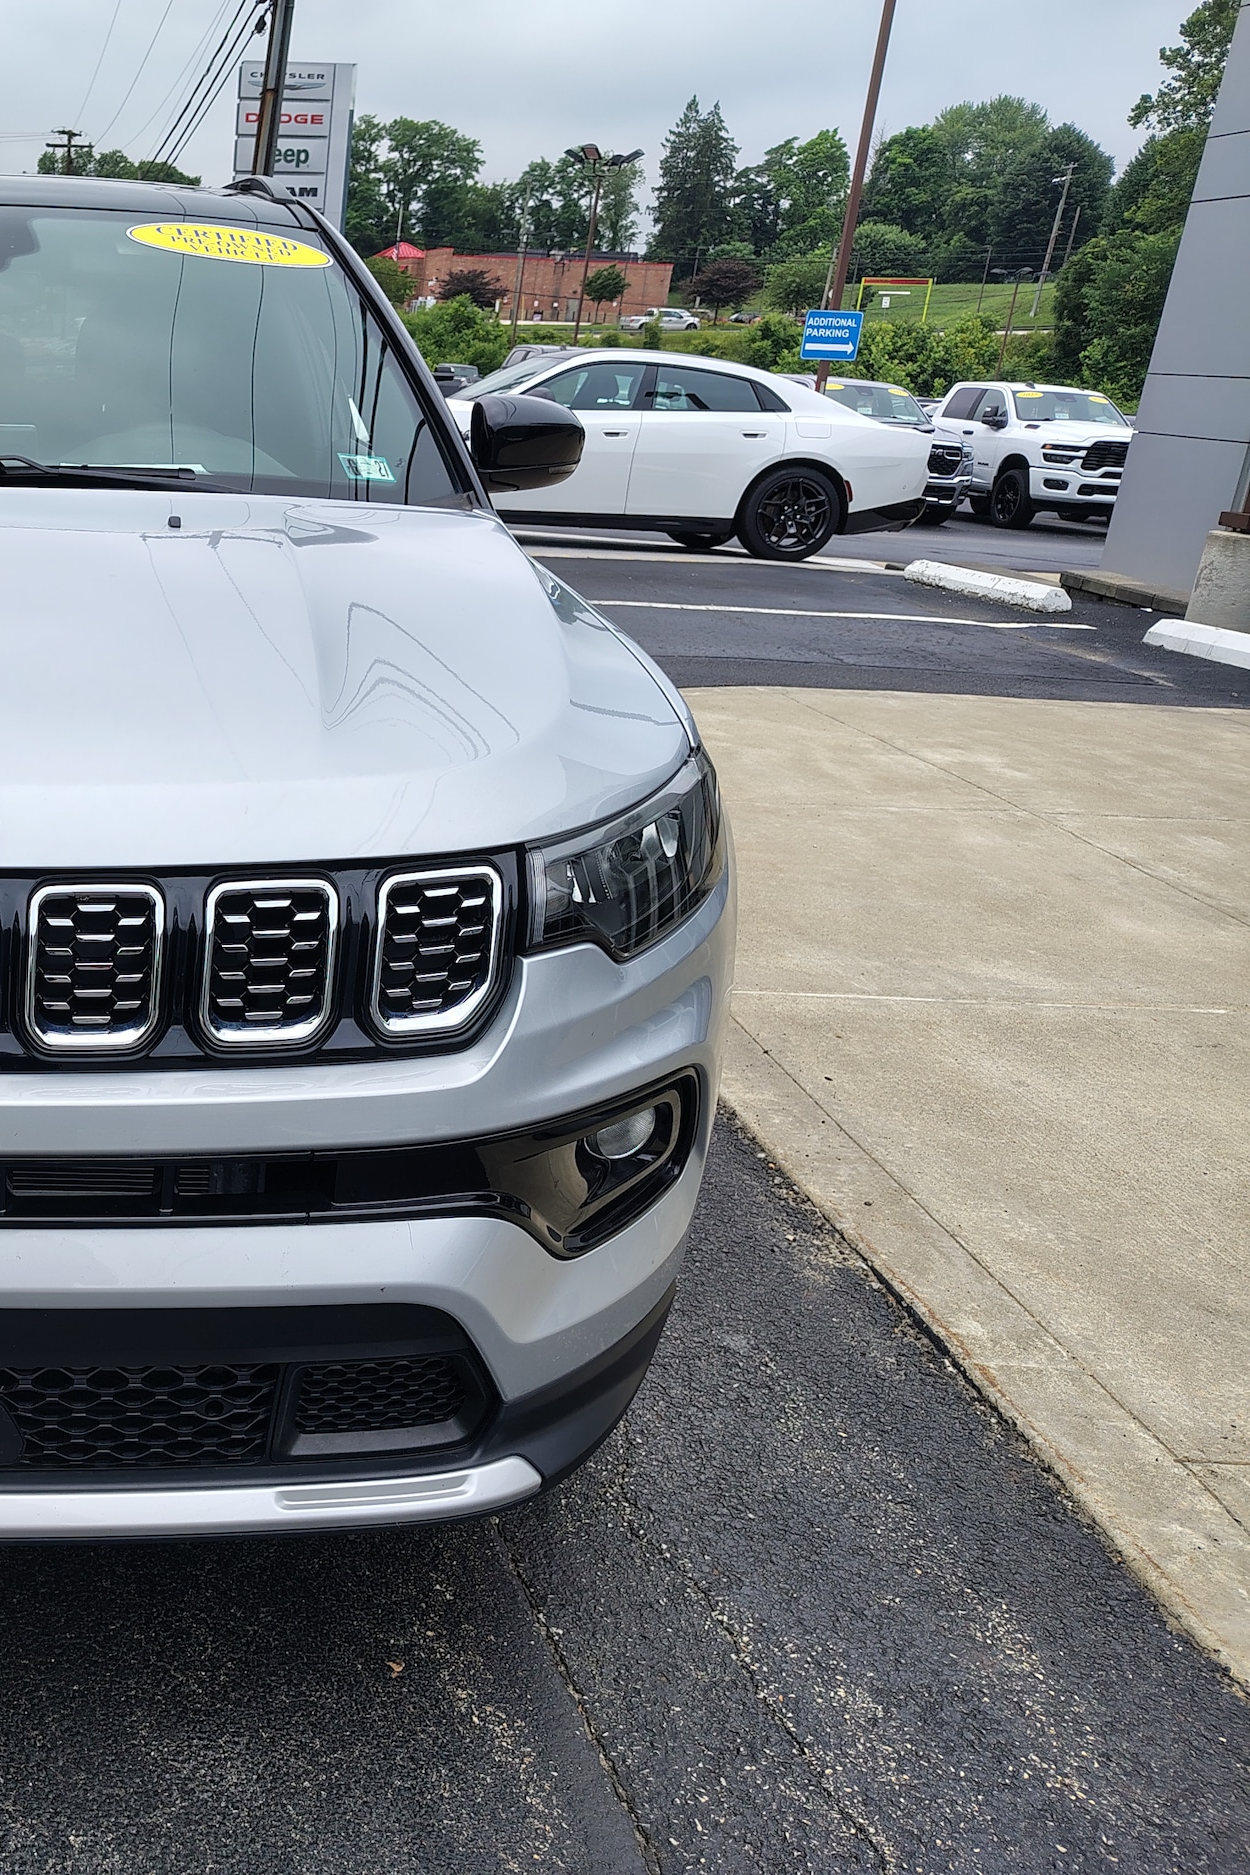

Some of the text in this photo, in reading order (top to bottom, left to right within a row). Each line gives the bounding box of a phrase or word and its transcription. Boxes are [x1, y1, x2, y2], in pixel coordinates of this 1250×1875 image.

[245, 113, 324, 125] DDGE
[273, 148, 310, 168] eep
[285, 186, 318, 197] AM
[155, 226, 298, 251] CERTIFIED
[190, 243, 281, 261] VEHICLE
[807, 317, 858, 328] ADDITIONAL
[805, 328, 850, 338] PARKING
